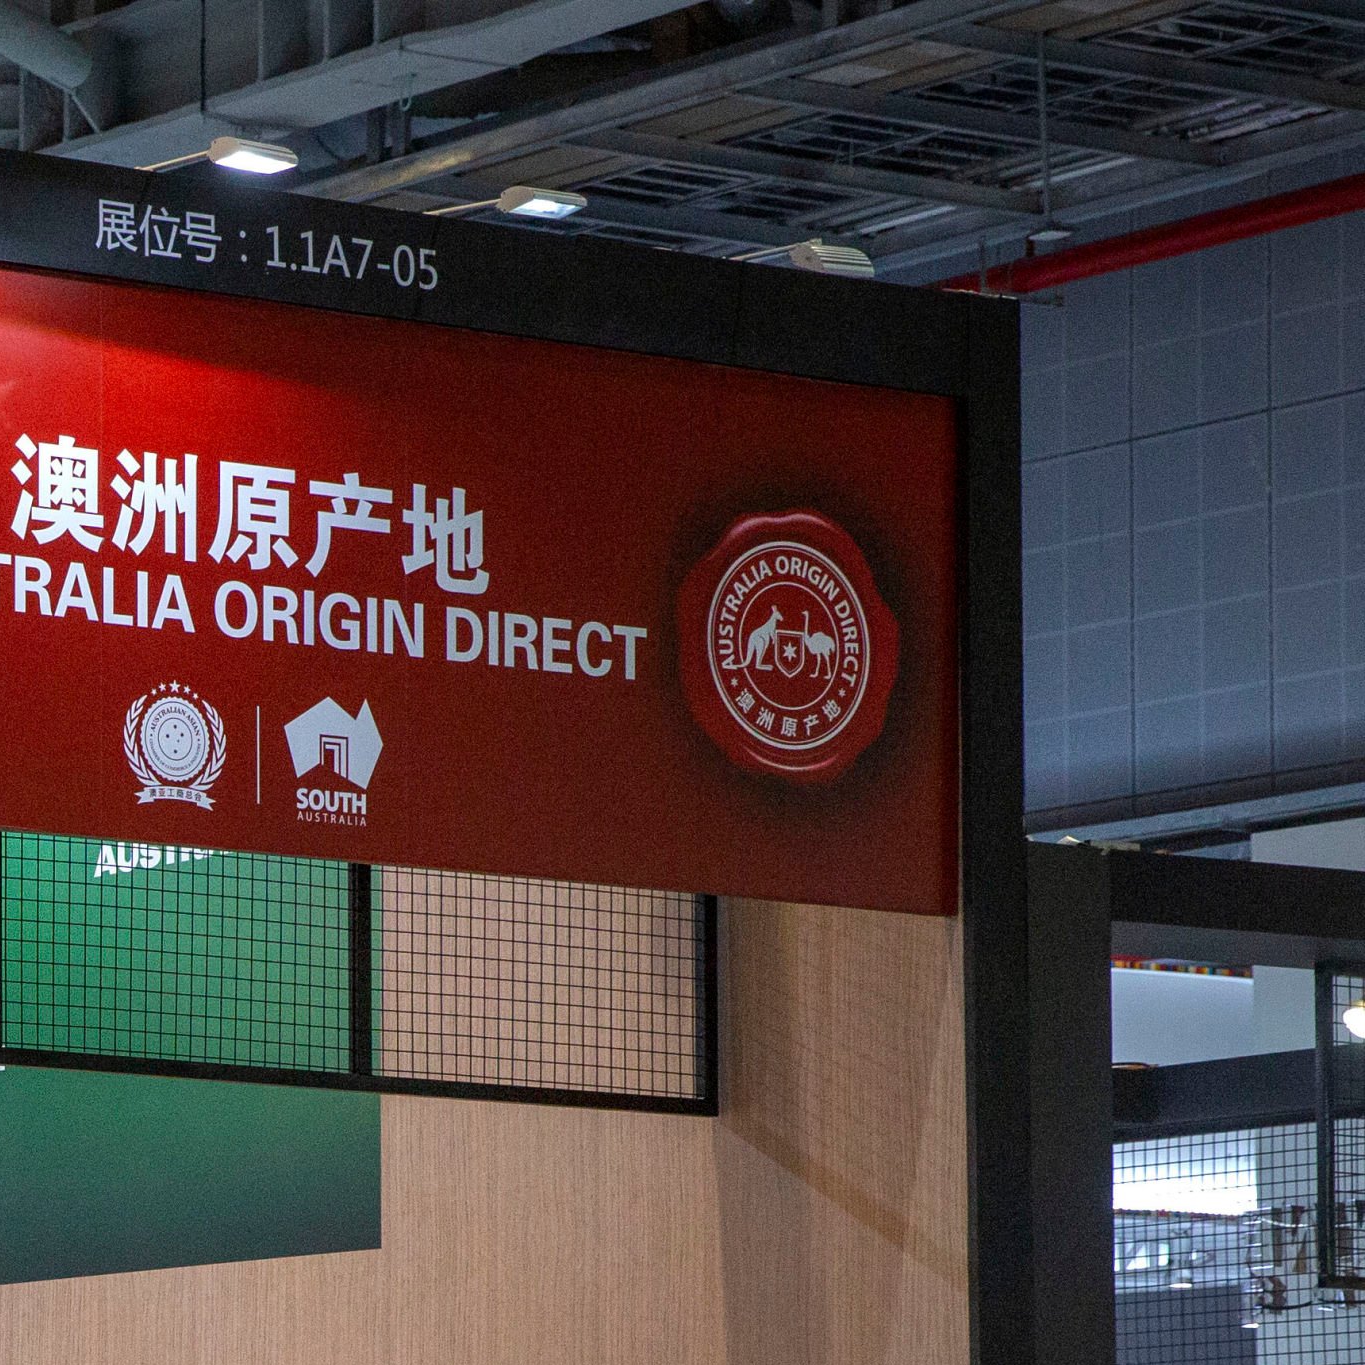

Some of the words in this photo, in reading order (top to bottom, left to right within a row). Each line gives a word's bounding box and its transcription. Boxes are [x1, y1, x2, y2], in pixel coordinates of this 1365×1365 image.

[10, 434, 491, 595] 澳洲原产地
[213, 579, 425, 660] ORIGIN
[446, 607, 649, 682] DIRECT
[718, 559, 773, 671] AUSTRALIA
[775, 555, 840, 601] ORIGIN
[834, 599, 860, 688] DIRECT
[734, 687, 842, 738] 澳洲原产地
[296, 787, 367, 816] SOUTH
[297, 811, 367, 827] AUSTRALIA
